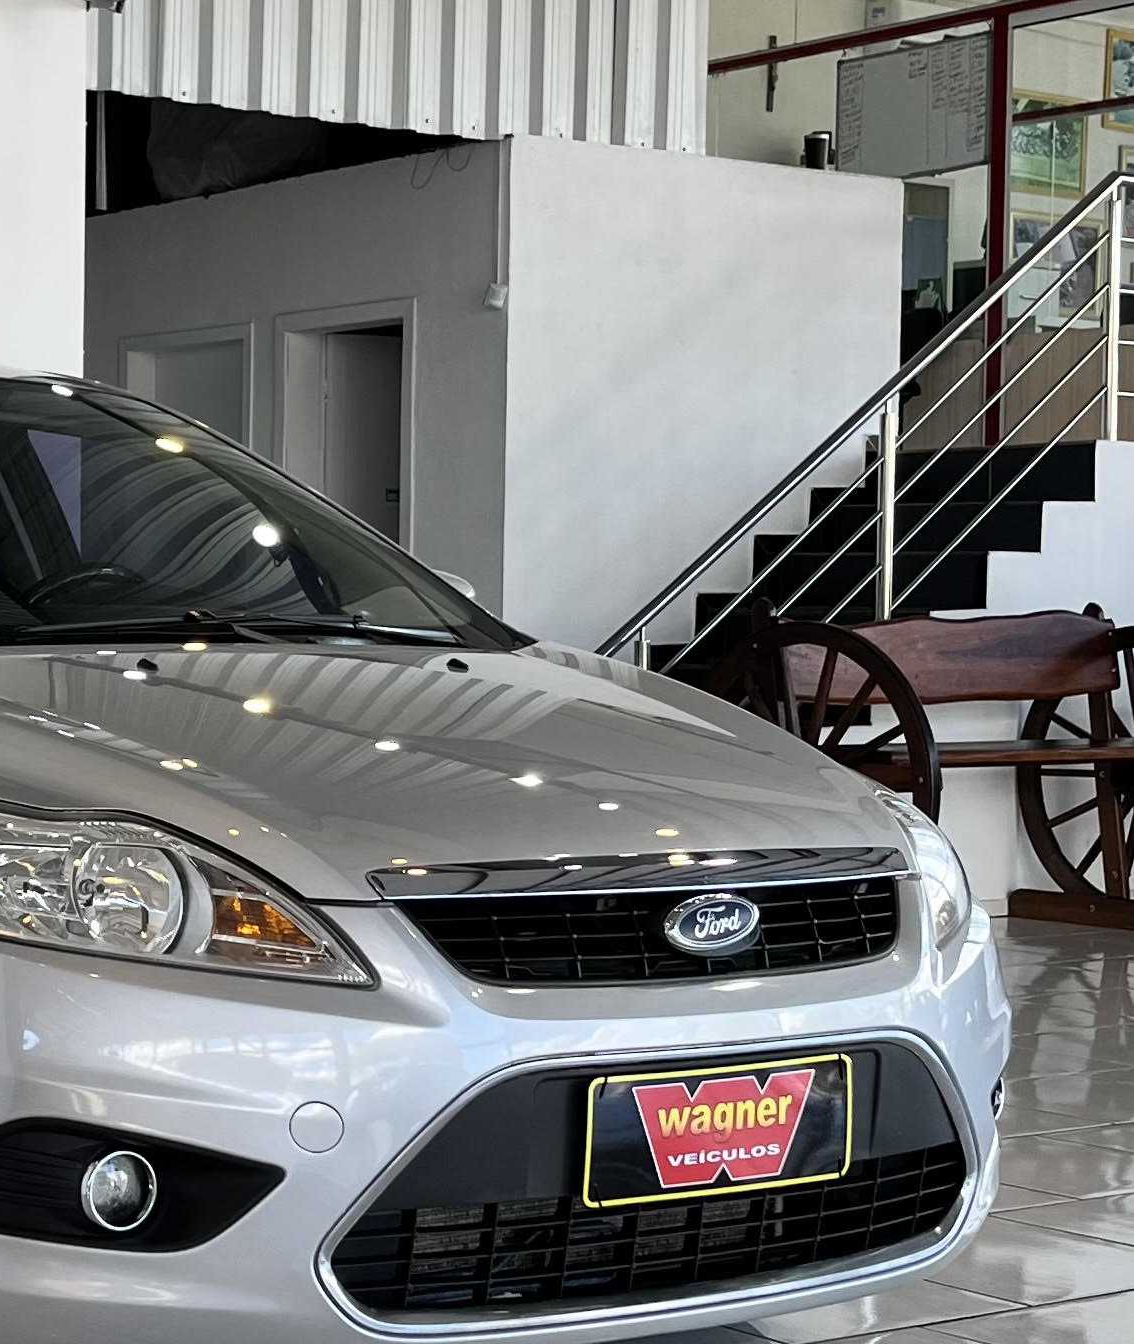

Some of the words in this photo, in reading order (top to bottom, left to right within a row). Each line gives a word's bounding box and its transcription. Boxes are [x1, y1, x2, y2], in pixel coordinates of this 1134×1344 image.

[694, 904, 743, 939] Ford
[657, 1094, 793, 1144] wagner
[667, 1142, 781, 1167] VEÍCULOS
